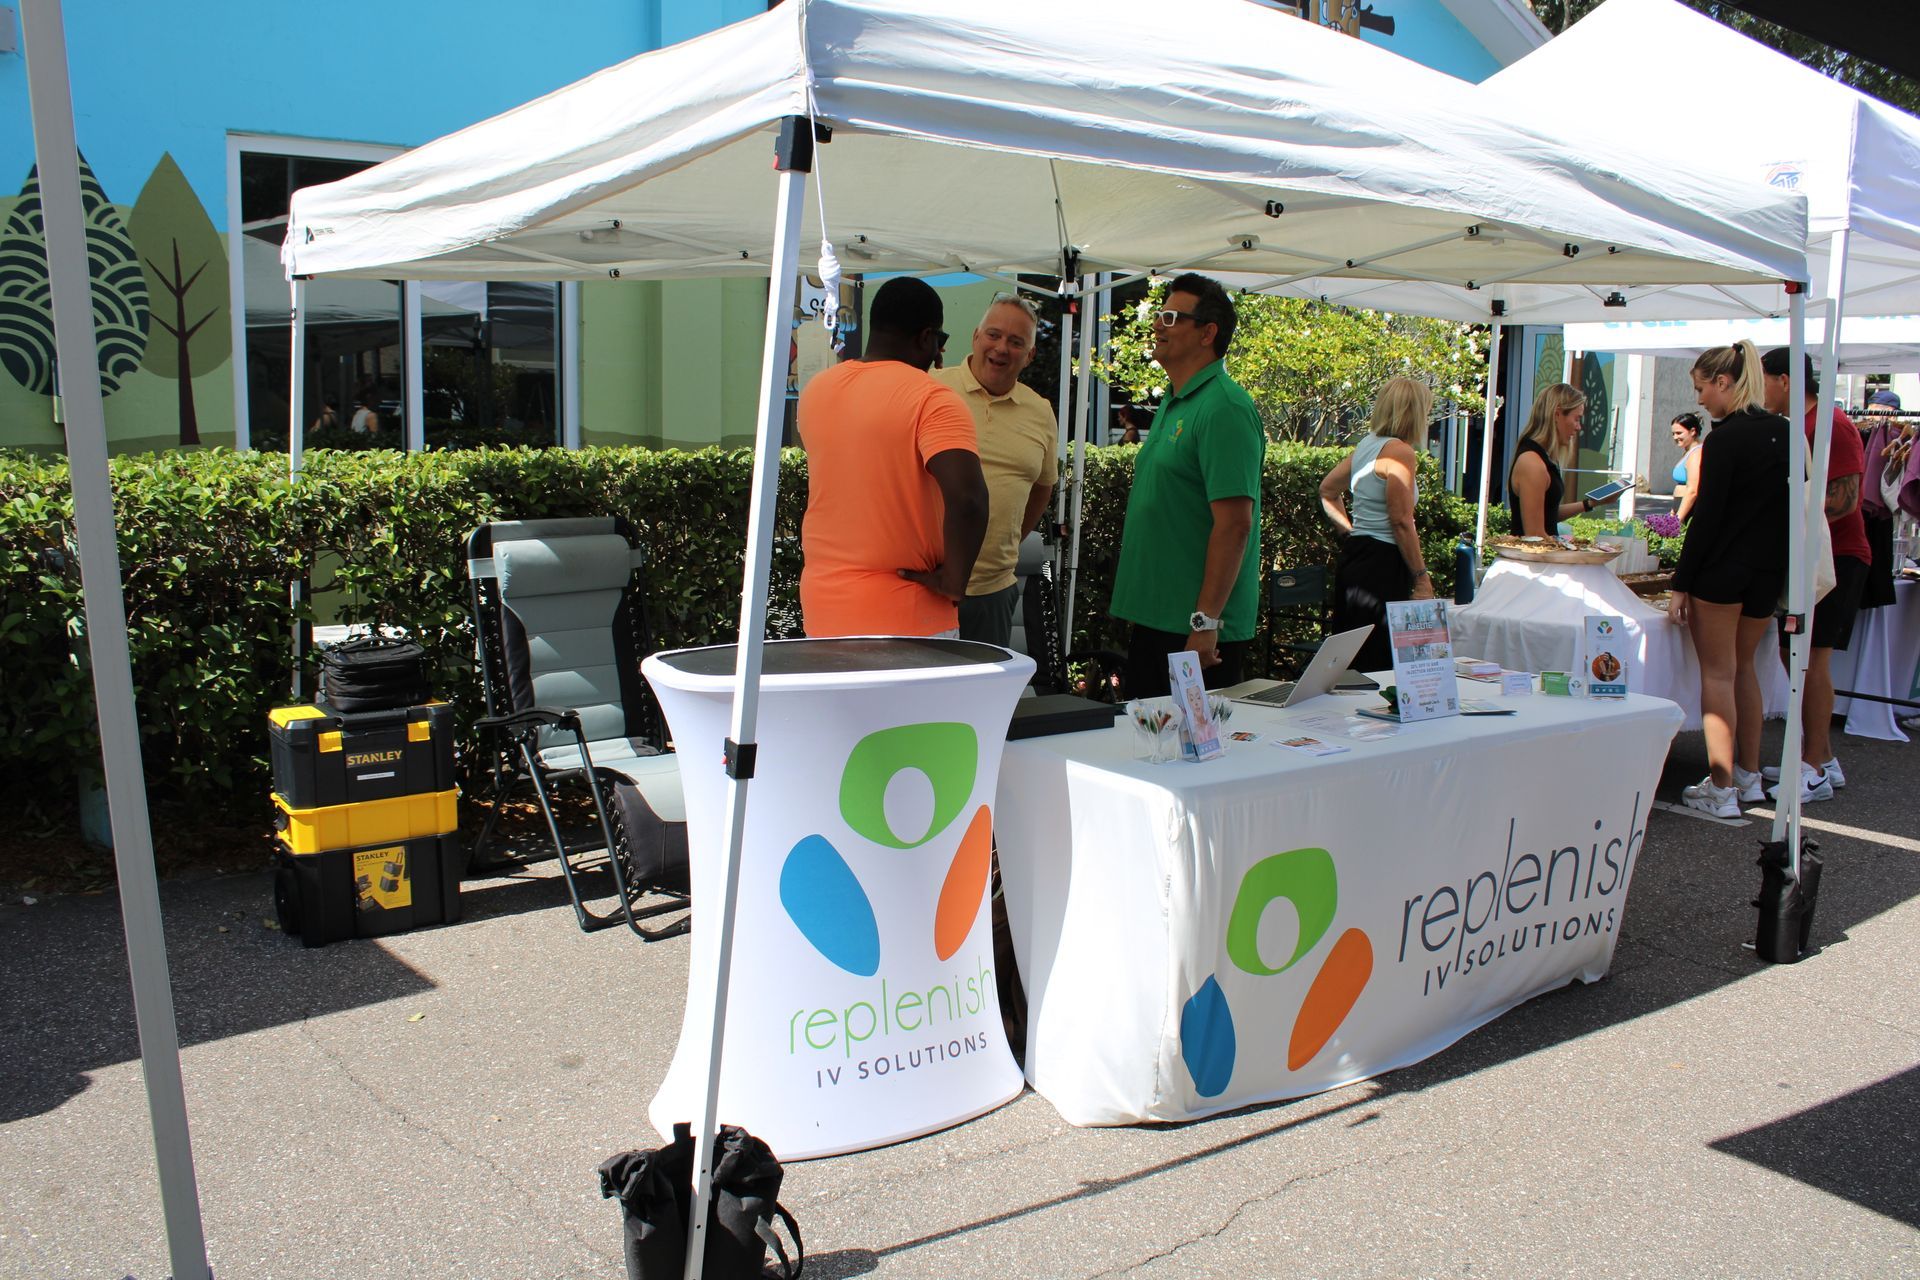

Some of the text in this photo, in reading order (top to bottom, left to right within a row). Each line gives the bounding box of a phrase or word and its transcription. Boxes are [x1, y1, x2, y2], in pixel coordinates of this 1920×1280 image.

[347, 750, 402, 765] STANLEY
[356, 851, 389, 861] STANLEY
[1398, 791, 1642, 972] replenish
[1424, 907, 1614, 996] IV SOLUTIONS
[789, 955, 996, 1058] replenish
[816, 1031, 987, 1088] IV SOLUTIONS
